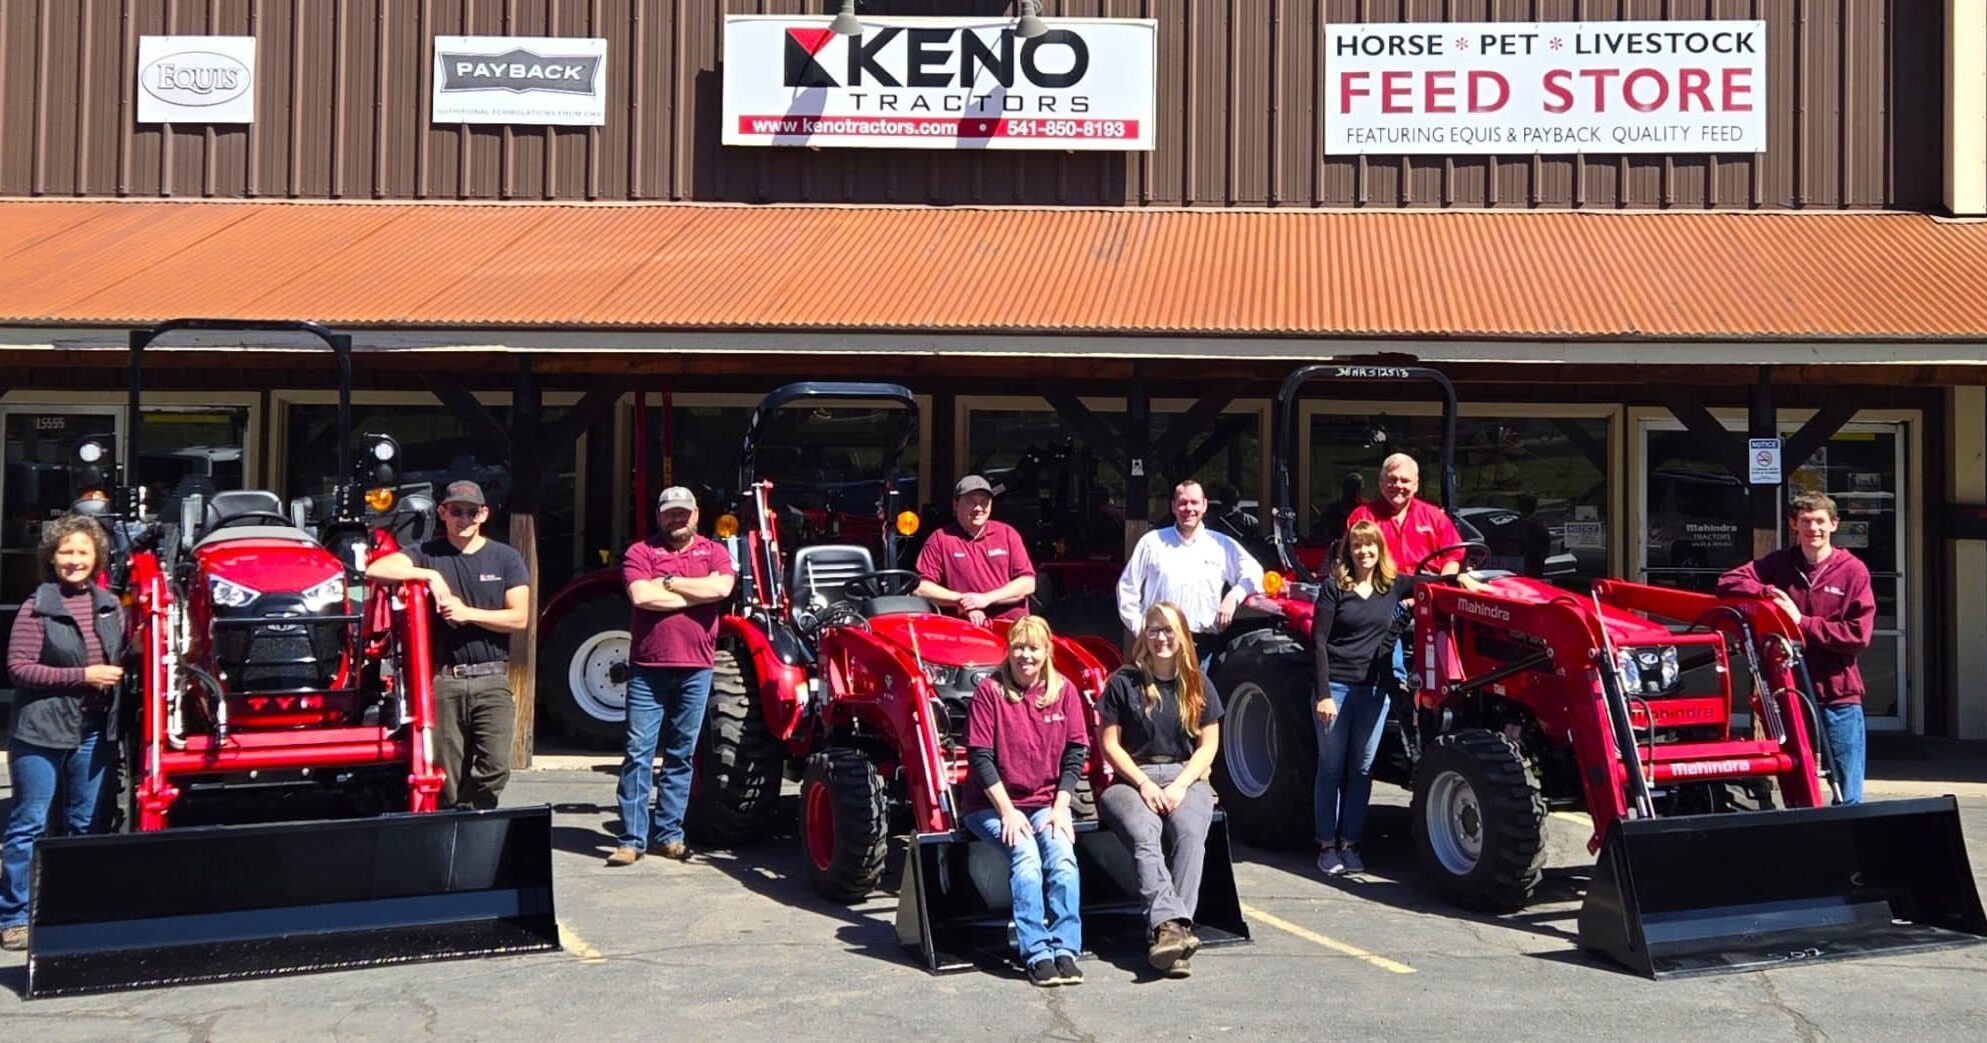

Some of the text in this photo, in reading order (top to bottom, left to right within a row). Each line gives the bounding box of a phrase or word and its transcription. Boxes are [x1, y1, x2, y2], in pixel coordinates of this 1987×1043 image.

[1336, 32, 1756, 56] HORSE PET LIVESTOCK
[848, 28, 1089, 88] KENO
[457, 62, 585, 81] PAYBACK
[1340, 68, 1753, 114] FEED STORE
[849, 93, 1090, 112] TRACTORS
[752, 118, 1125, 136] wwwkenotractors.com 541-850-8193
[1347, 125, 1743, 145] FEATURING EQUIS & PAYBACK QUALITY FEED
